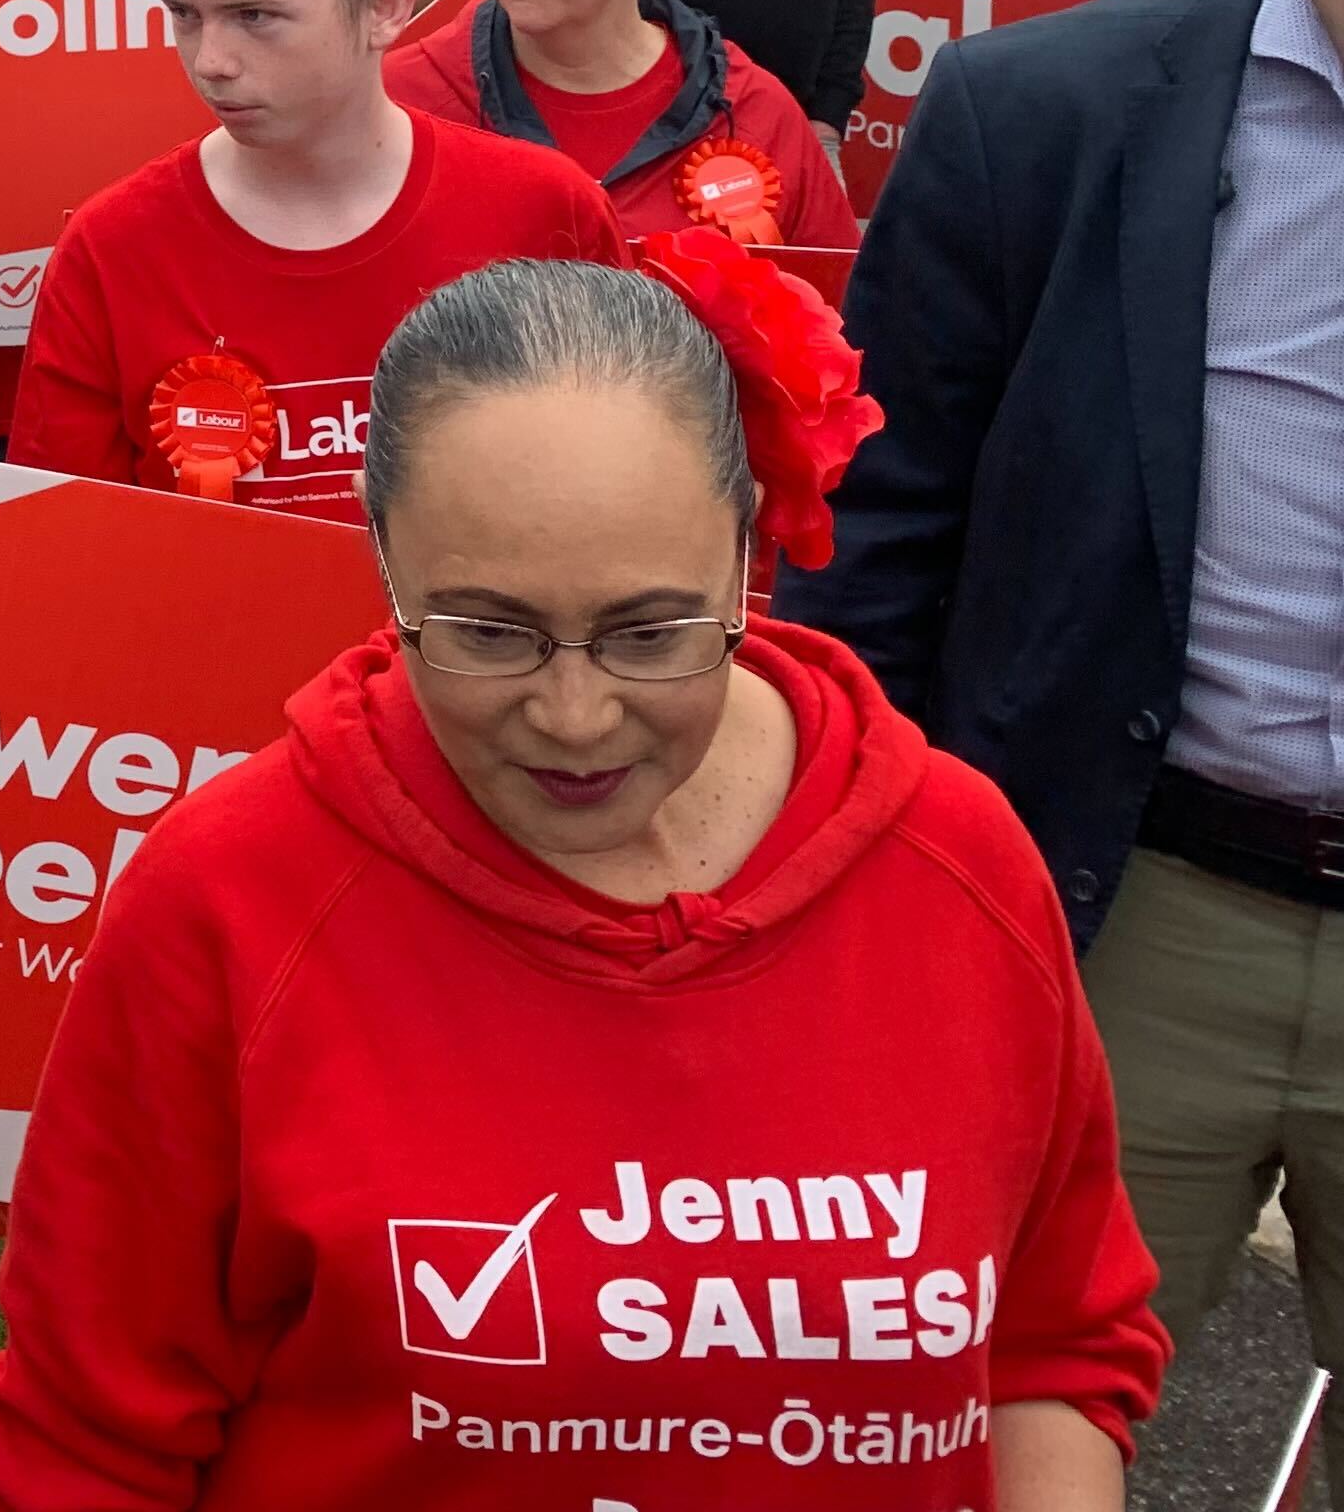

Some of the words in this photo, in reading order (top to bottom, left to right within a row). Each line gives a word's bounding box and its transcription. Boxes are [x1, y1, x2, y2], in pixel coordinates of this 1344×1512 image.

[199, 413, 241, 428] Labour
[579, 1162, 927, 1259] Jenny
[412, 1391, 988, 1466] Panmure-Ōtāhuh
